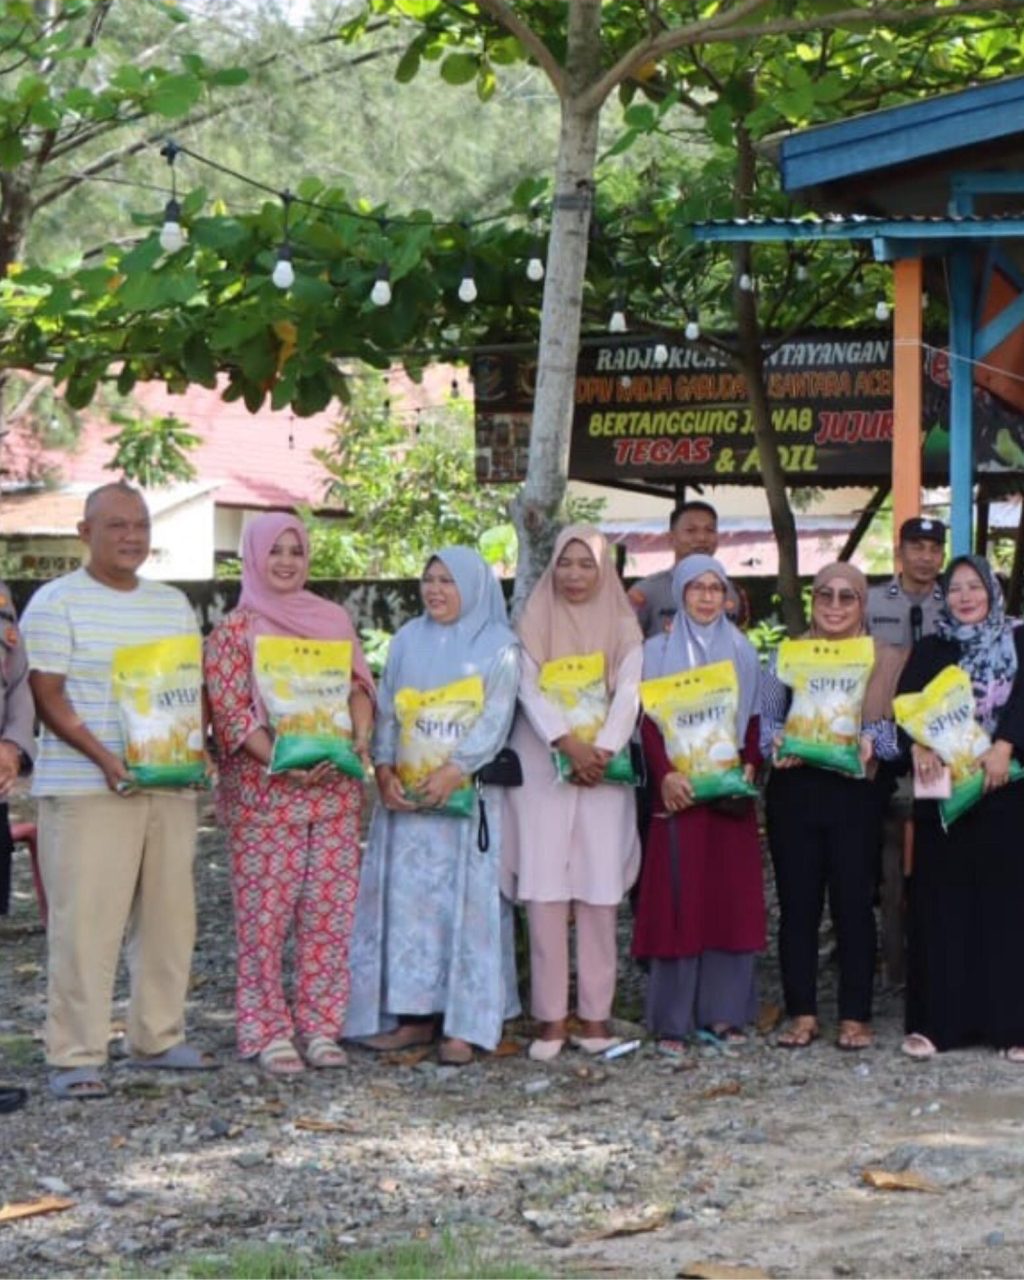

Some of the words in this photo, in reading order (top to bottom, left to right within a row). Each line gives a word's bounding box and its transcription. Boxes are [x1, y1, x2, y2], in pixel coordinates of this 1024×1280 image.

[589, 410, 738, 436] BERTANGGUNG
[815, 410, 894, 444] JUJUR
[614, 437, 713, 465] TEGAS
[714, 448, 735, 473] &
